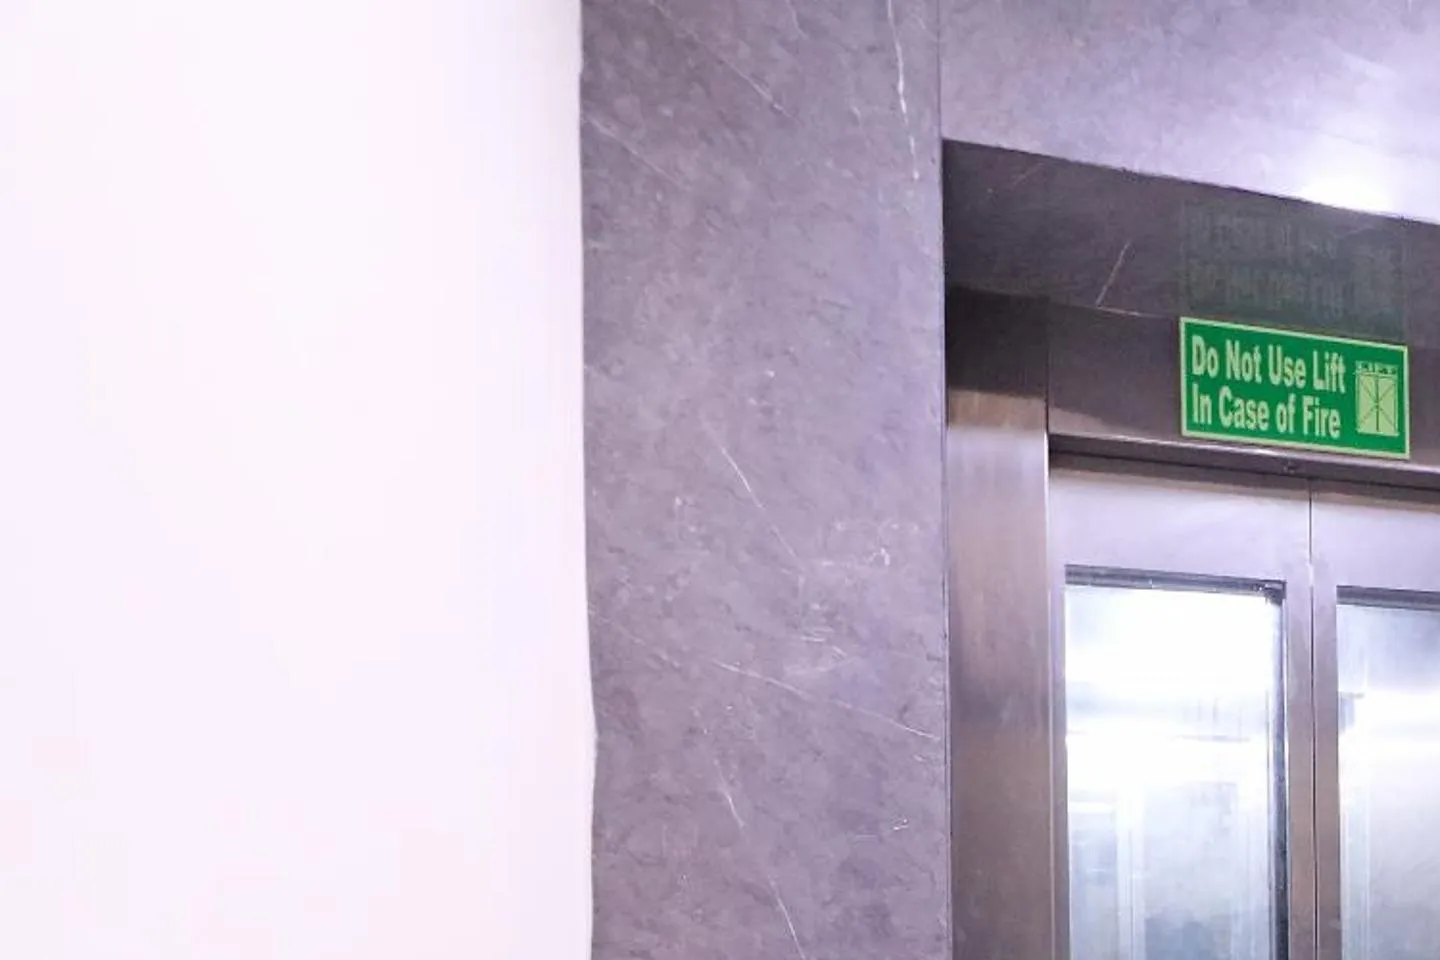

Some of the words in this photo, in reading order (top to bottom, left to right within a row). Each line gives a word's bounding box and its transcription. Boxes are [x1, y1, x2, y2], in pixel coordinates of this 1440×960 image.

[1191, 335, 1219, 378] Do
[1225, 339, 1262, 384] Not
[1268, 344, 1307, 389] Use
[1312, 350, 1346, 393] Lift
[1191, 383, 1212, 425] In
[1218, 385, 1270, 431] Case
[1276, 393, 1296, 434] of
[1302, 395, 1341, 438] Fire
